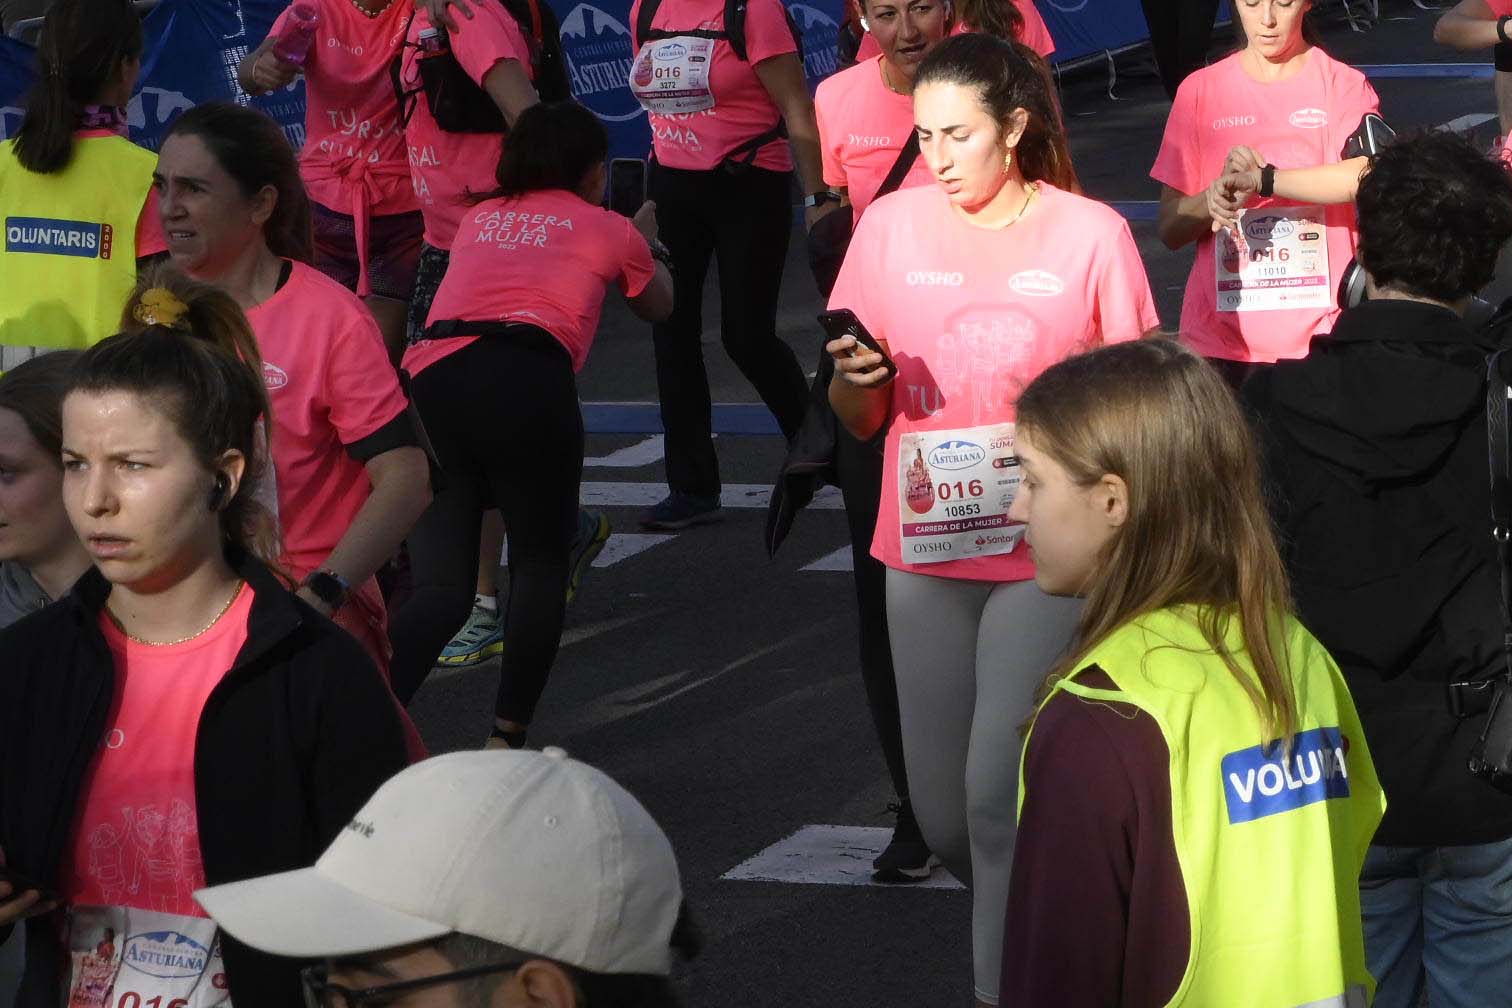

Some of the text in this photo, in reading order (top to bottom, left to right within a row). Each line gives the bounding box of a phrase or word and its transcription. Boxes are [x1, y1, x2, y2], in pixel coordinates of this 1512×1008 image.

[655, 66, 680, 79] 016
[660, 81, 676, 89] 3272
[1213, 115, 1256, 131] OYSHO
[474, 210, 573, 232] CARRERA
[485, 219, 547, 235] DE LA
[475, 230, 547, 248] MUJER
[1250, 247, 1290, 263] 016
[906, 271, 964, 287] OYSHO
[932, 453, 980, 465] ASTURIANA
[938, 479, 984, 500] 016
[945, 503, 980, 517] 10853
[915, 518, 1002, 533] CARRERA DE LA MUJER
[913, 541, 952, 554] OYSHO
[986, 535, 1014, 545] Santa
[126, 943, 204, 971] ASTURIANA
